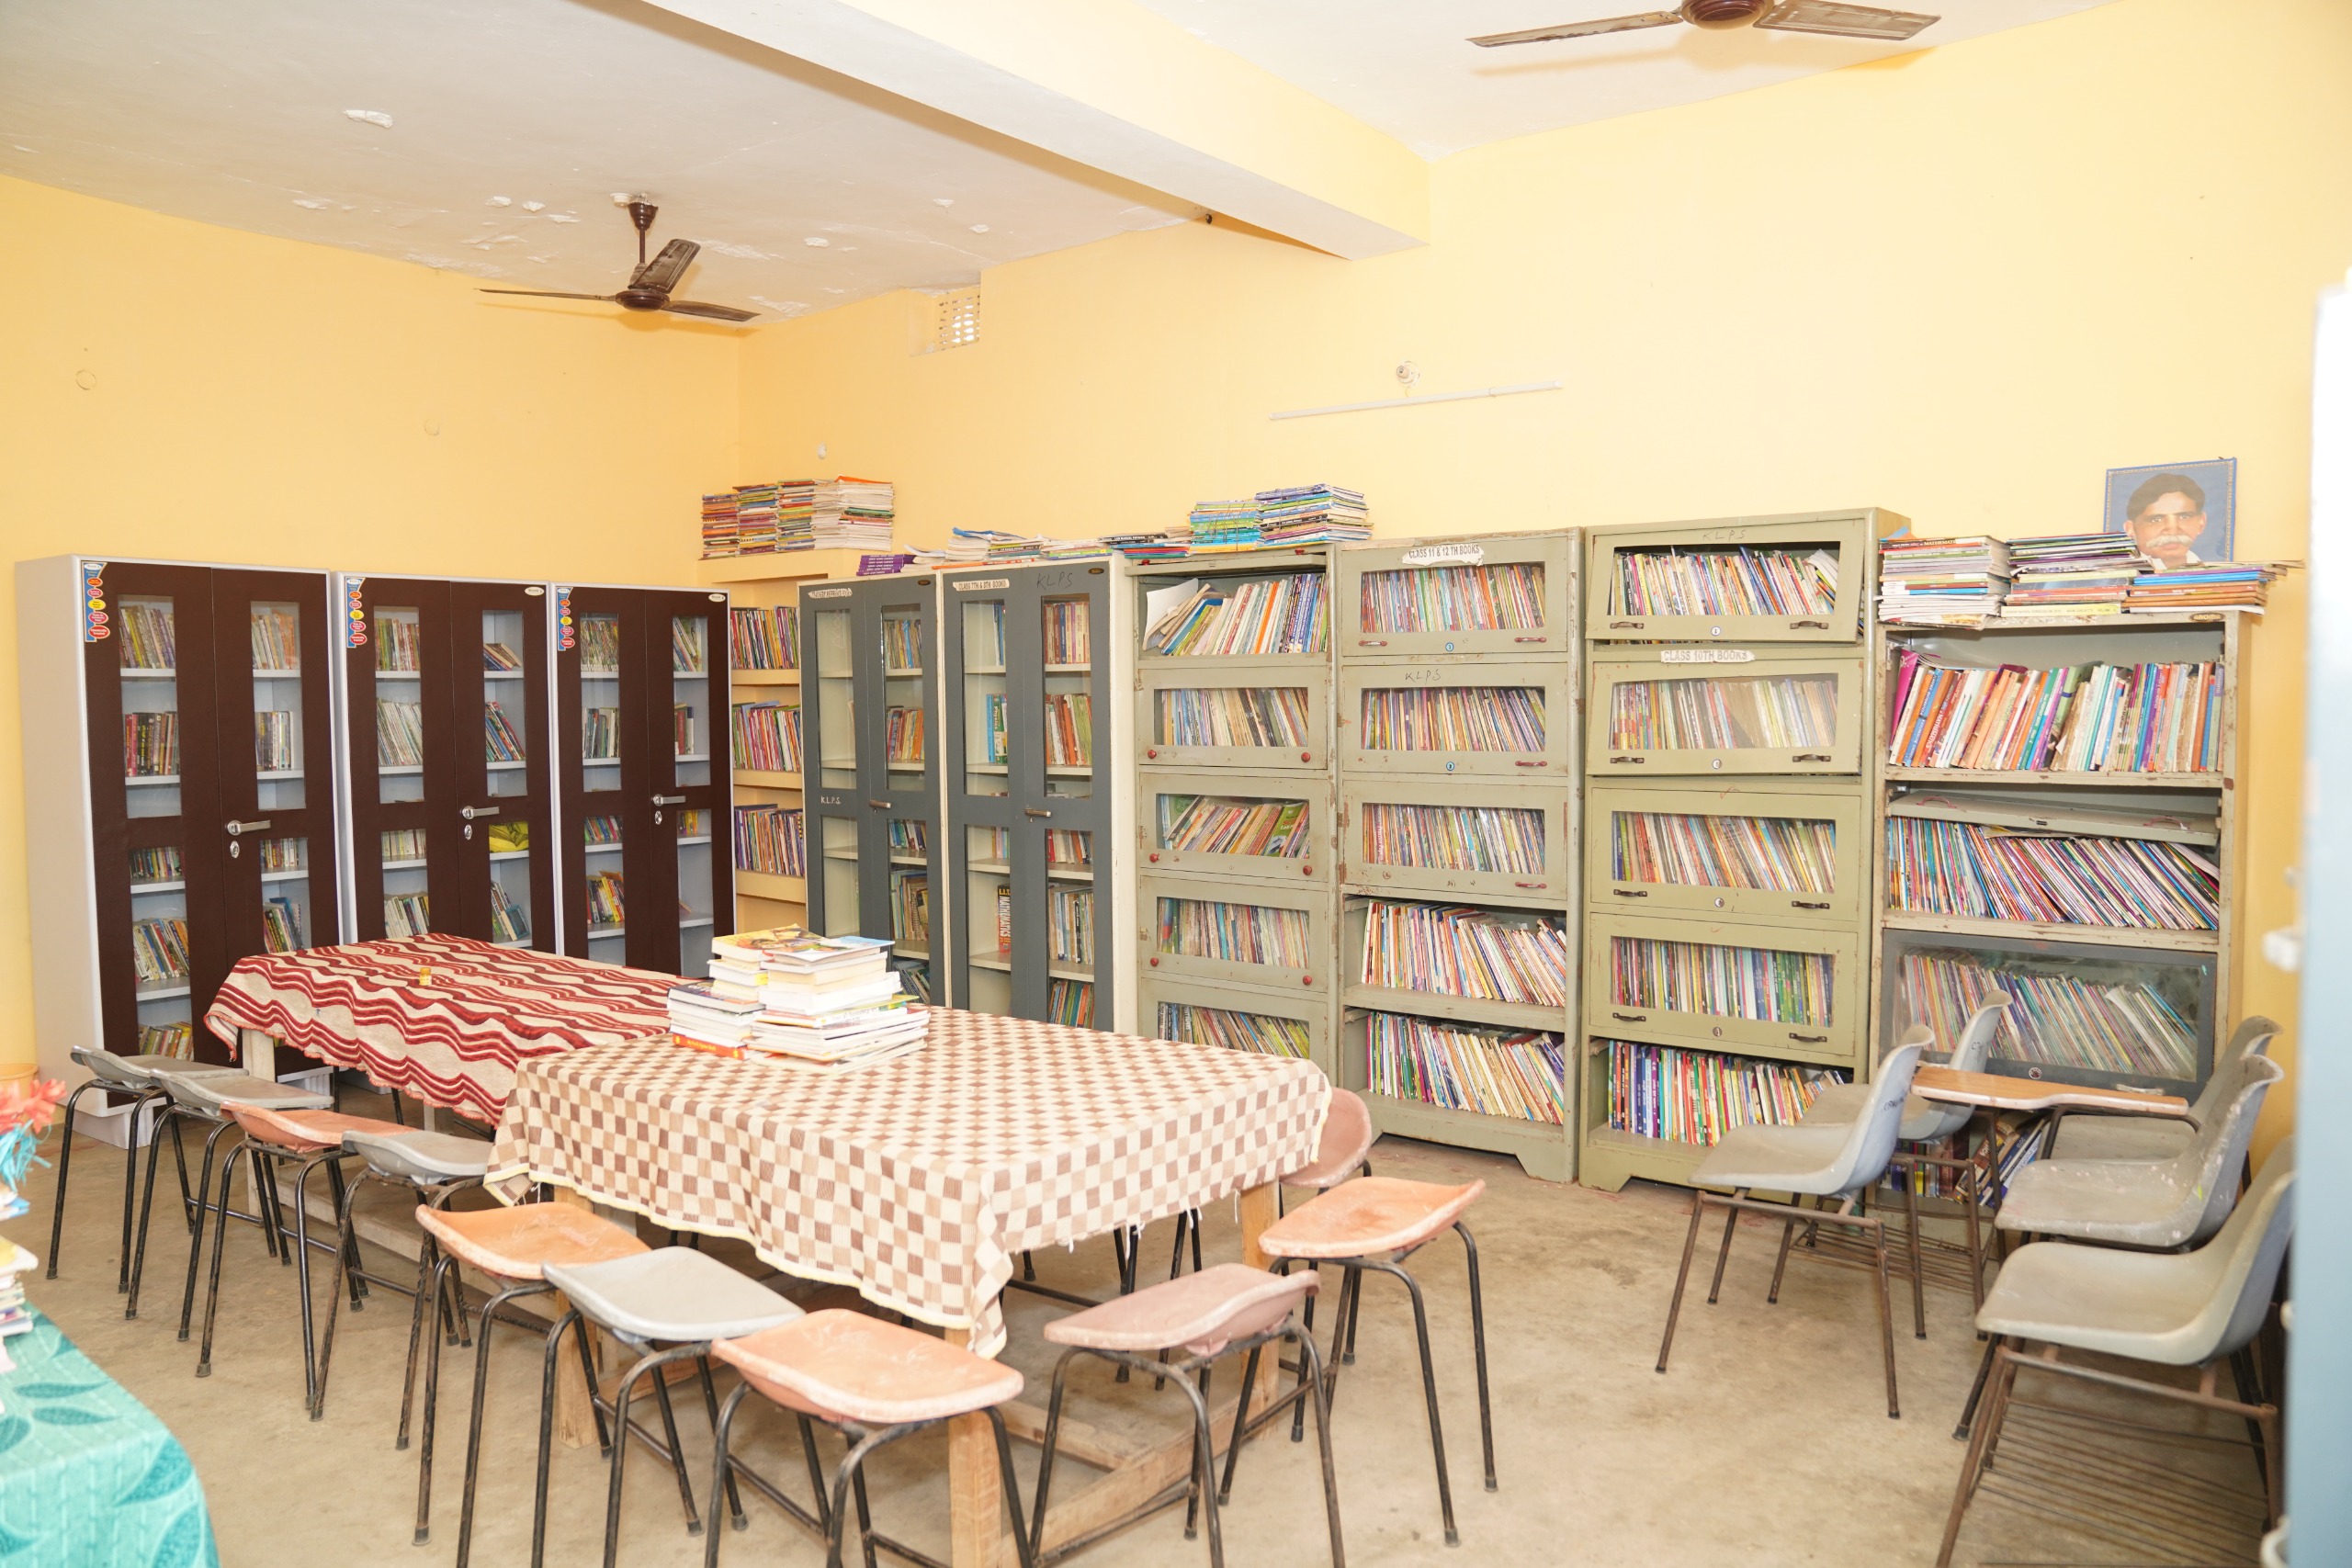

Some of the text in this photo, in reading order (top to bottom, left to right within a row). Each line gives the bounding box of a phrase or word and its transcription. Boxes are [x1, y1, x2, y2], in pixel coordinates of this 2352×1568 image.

[1408, 544, 1480, 558] CLASS 11 & 12 TH BOOKS
[1037, 571, 1073, 591] KLPS
[1664, 649, 1747, 661] CLASS 10TH BOOKS
[1406, 669, 1441, 685] KLPS
[999, 896, 1011, 938] MATHEMATICS
